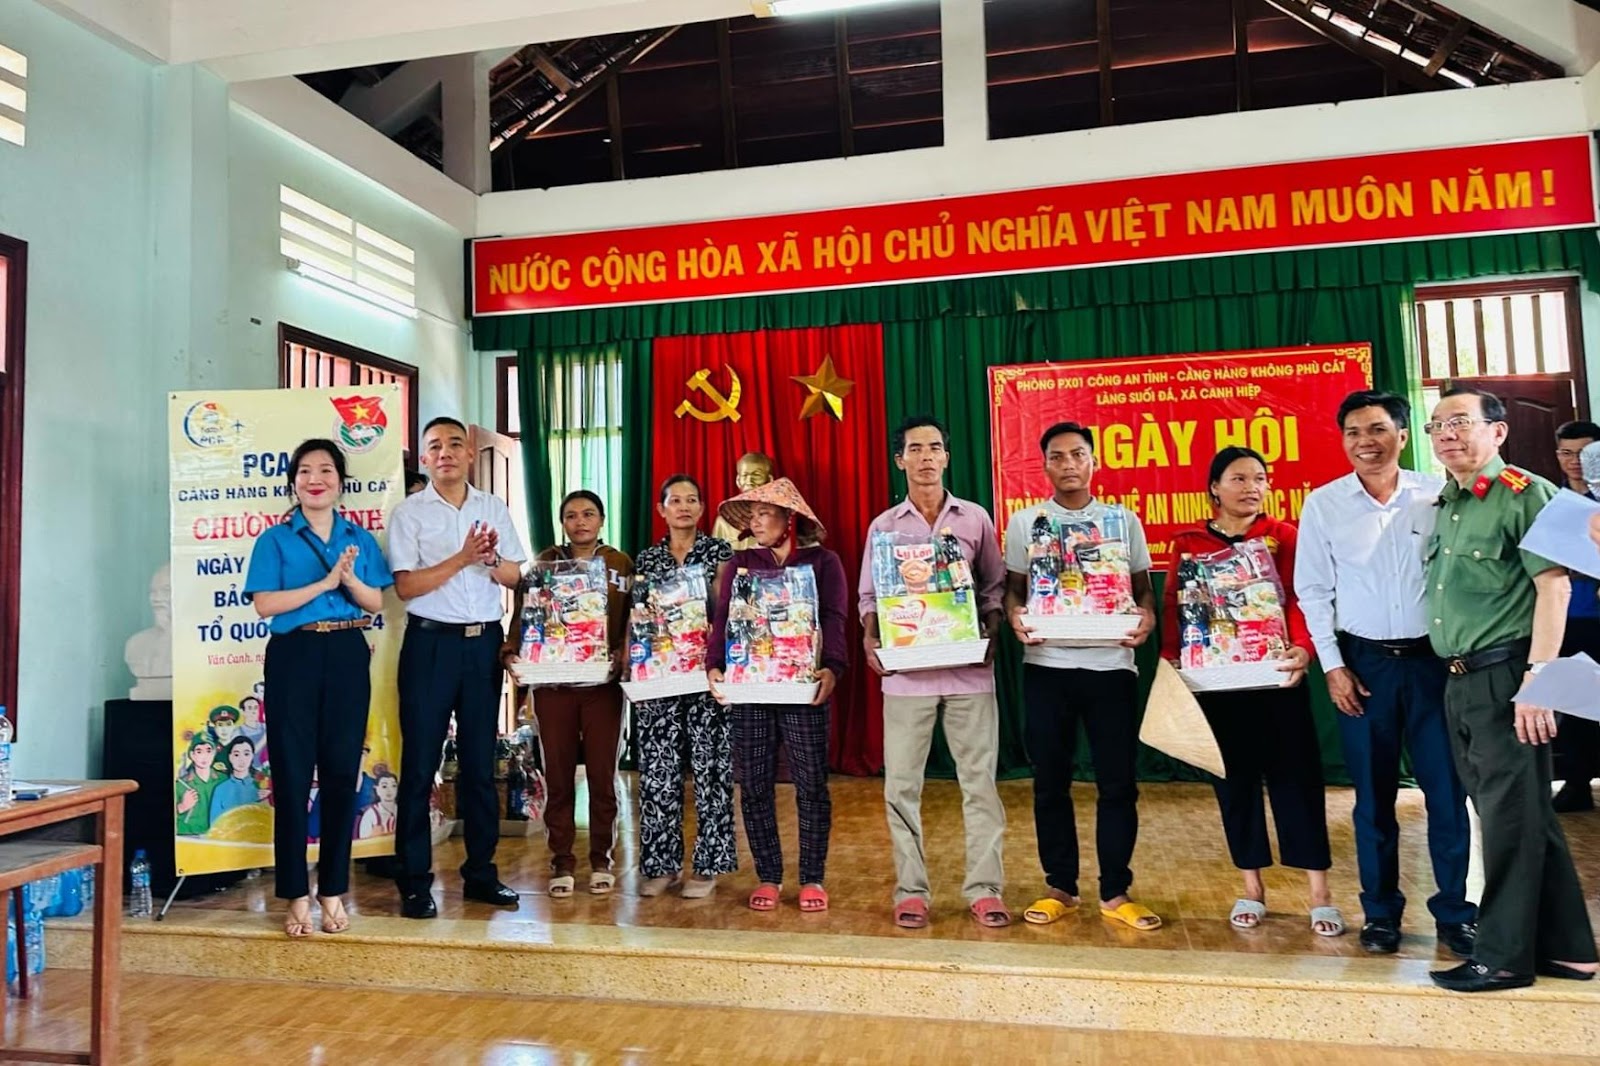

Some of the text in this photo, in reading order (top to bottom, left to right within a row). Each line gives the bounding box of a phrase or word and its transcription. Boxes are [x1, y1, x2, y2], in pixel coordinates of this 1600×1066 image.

[488, 254, 571, 295] NƯỚC
[582, 247, 667, 293] CỘNG
[678, 237, 744, 282] HÒA
[757, 231, 802, 274] XÃ
[813, 225, 871, 275] HỘI
[883, 211, 956, 264] CHỦ
[967, 203, 1077, 256] NGHĨA
[1084, 197, 1172, 247] VIỆT
[1185, 193, 1277, 235] NAM
[1291, 175, 1413, 226] MUÔN
[1430, 167, 1531, 215] NĂM
[1016, 376, 1055, 392] PHÒNG
[1057, 377, 1084, 389] PX01
[1087, 373, 1122, 388] CÔNG
[1124, 373, 1141, 385] AN
[1142, 368, 1168, 384] TỈNH
[1214, 365, 1249, 380] HÀNG
[1251, 362, 1294, 378] KHÔNG
[1296, 360, 1320, 375] PHÙ
[1322, 359, 1346, 373] CÁT
[1096, 390, 1127, 405] LÀNG
[1129, 387, 1155, 403] SUỐI
[1181, 386, 1198, 401] XÃ
[1199, 386, 1234, 400] CANH
[1236, 383, 1262, 400] HIỆP
[1213, 406, 1301, 473] HỘI
[226, 484, 268, 499] HÀNG
[1145, 493, 1168, 525] AN
[197, 553, 245, 576] NGÀY
[197, 615, 223, 642] TỔ
